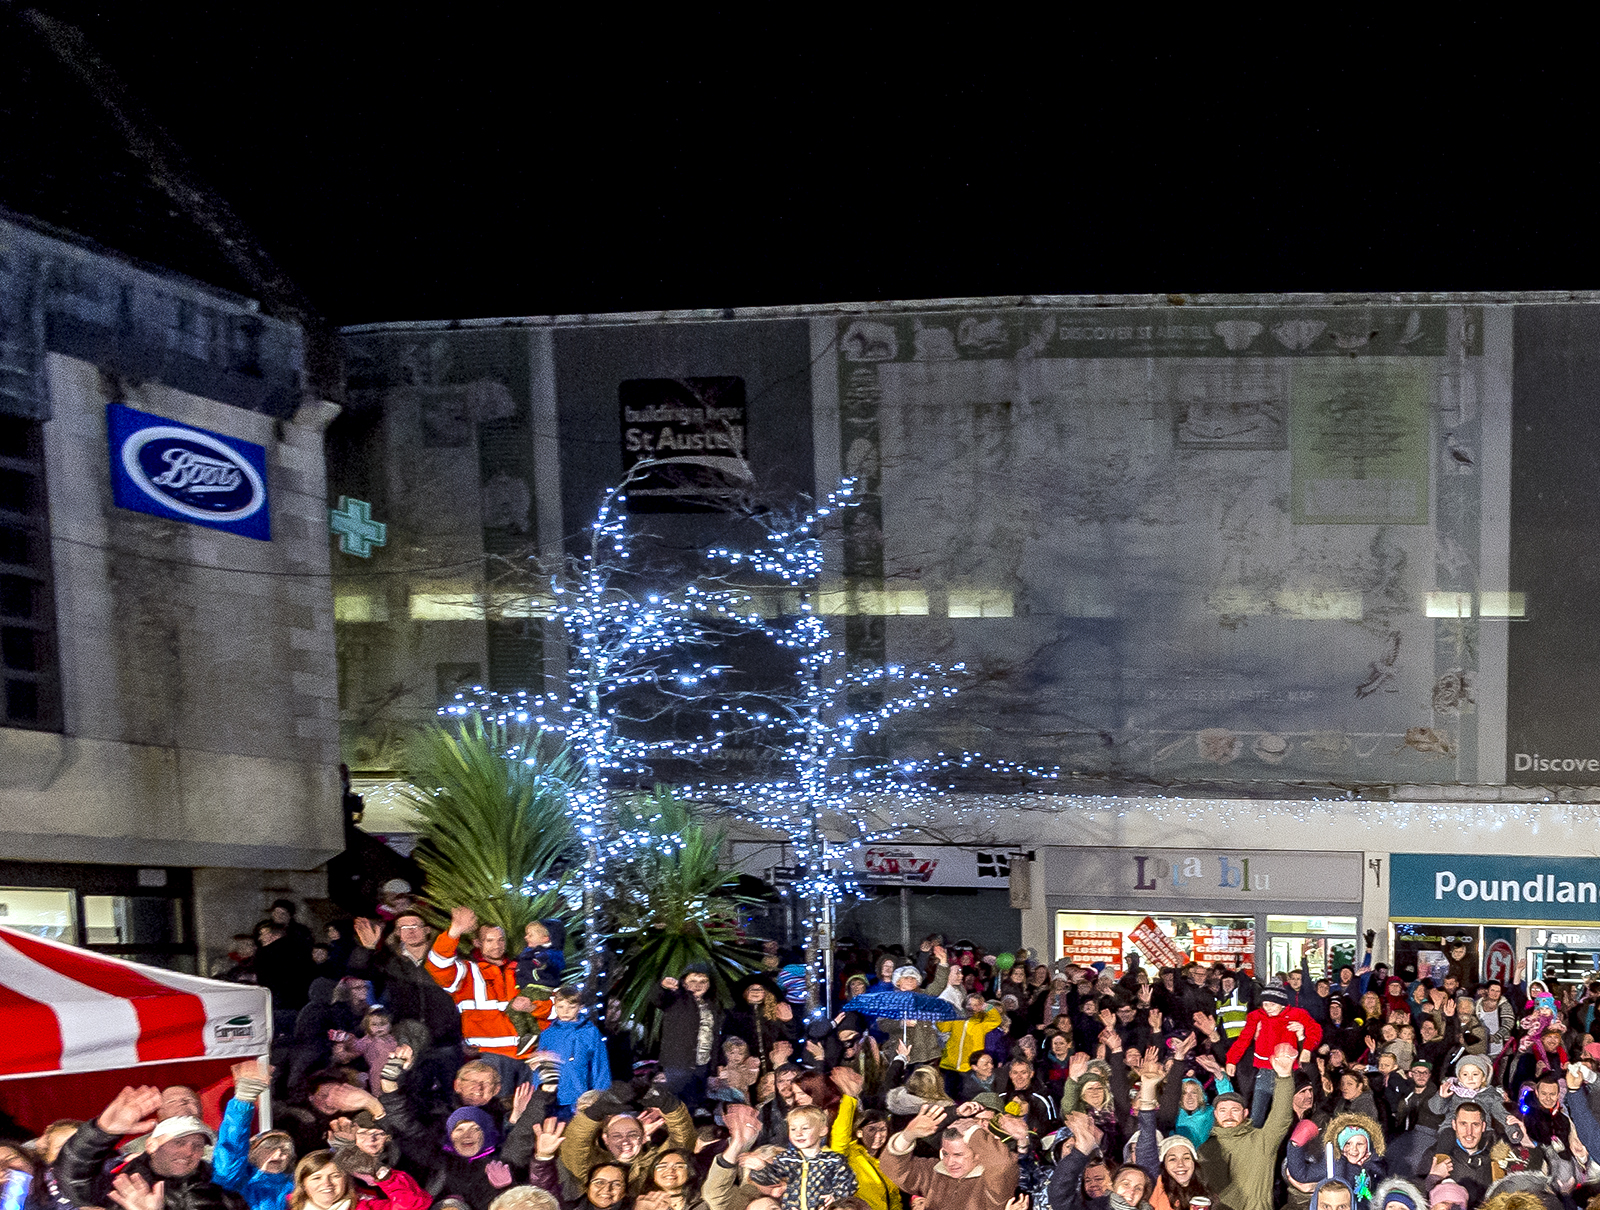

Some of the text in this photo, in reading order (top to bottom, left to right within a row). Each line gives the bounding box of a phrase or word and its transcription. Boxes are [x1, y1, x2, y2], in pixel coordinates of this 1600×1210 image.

[626, 427, 655, 452] St
[152, 448, 243, 493] Boots
[1217, 856, 1271, 892] blu
[1065, 931, 1120, 939] CLOSING
[1072, 939, 1113, 947] DOWN
[1065, 947, 1120, 955] CLOSING
[1072, 955, 1114, 963] DOWN
